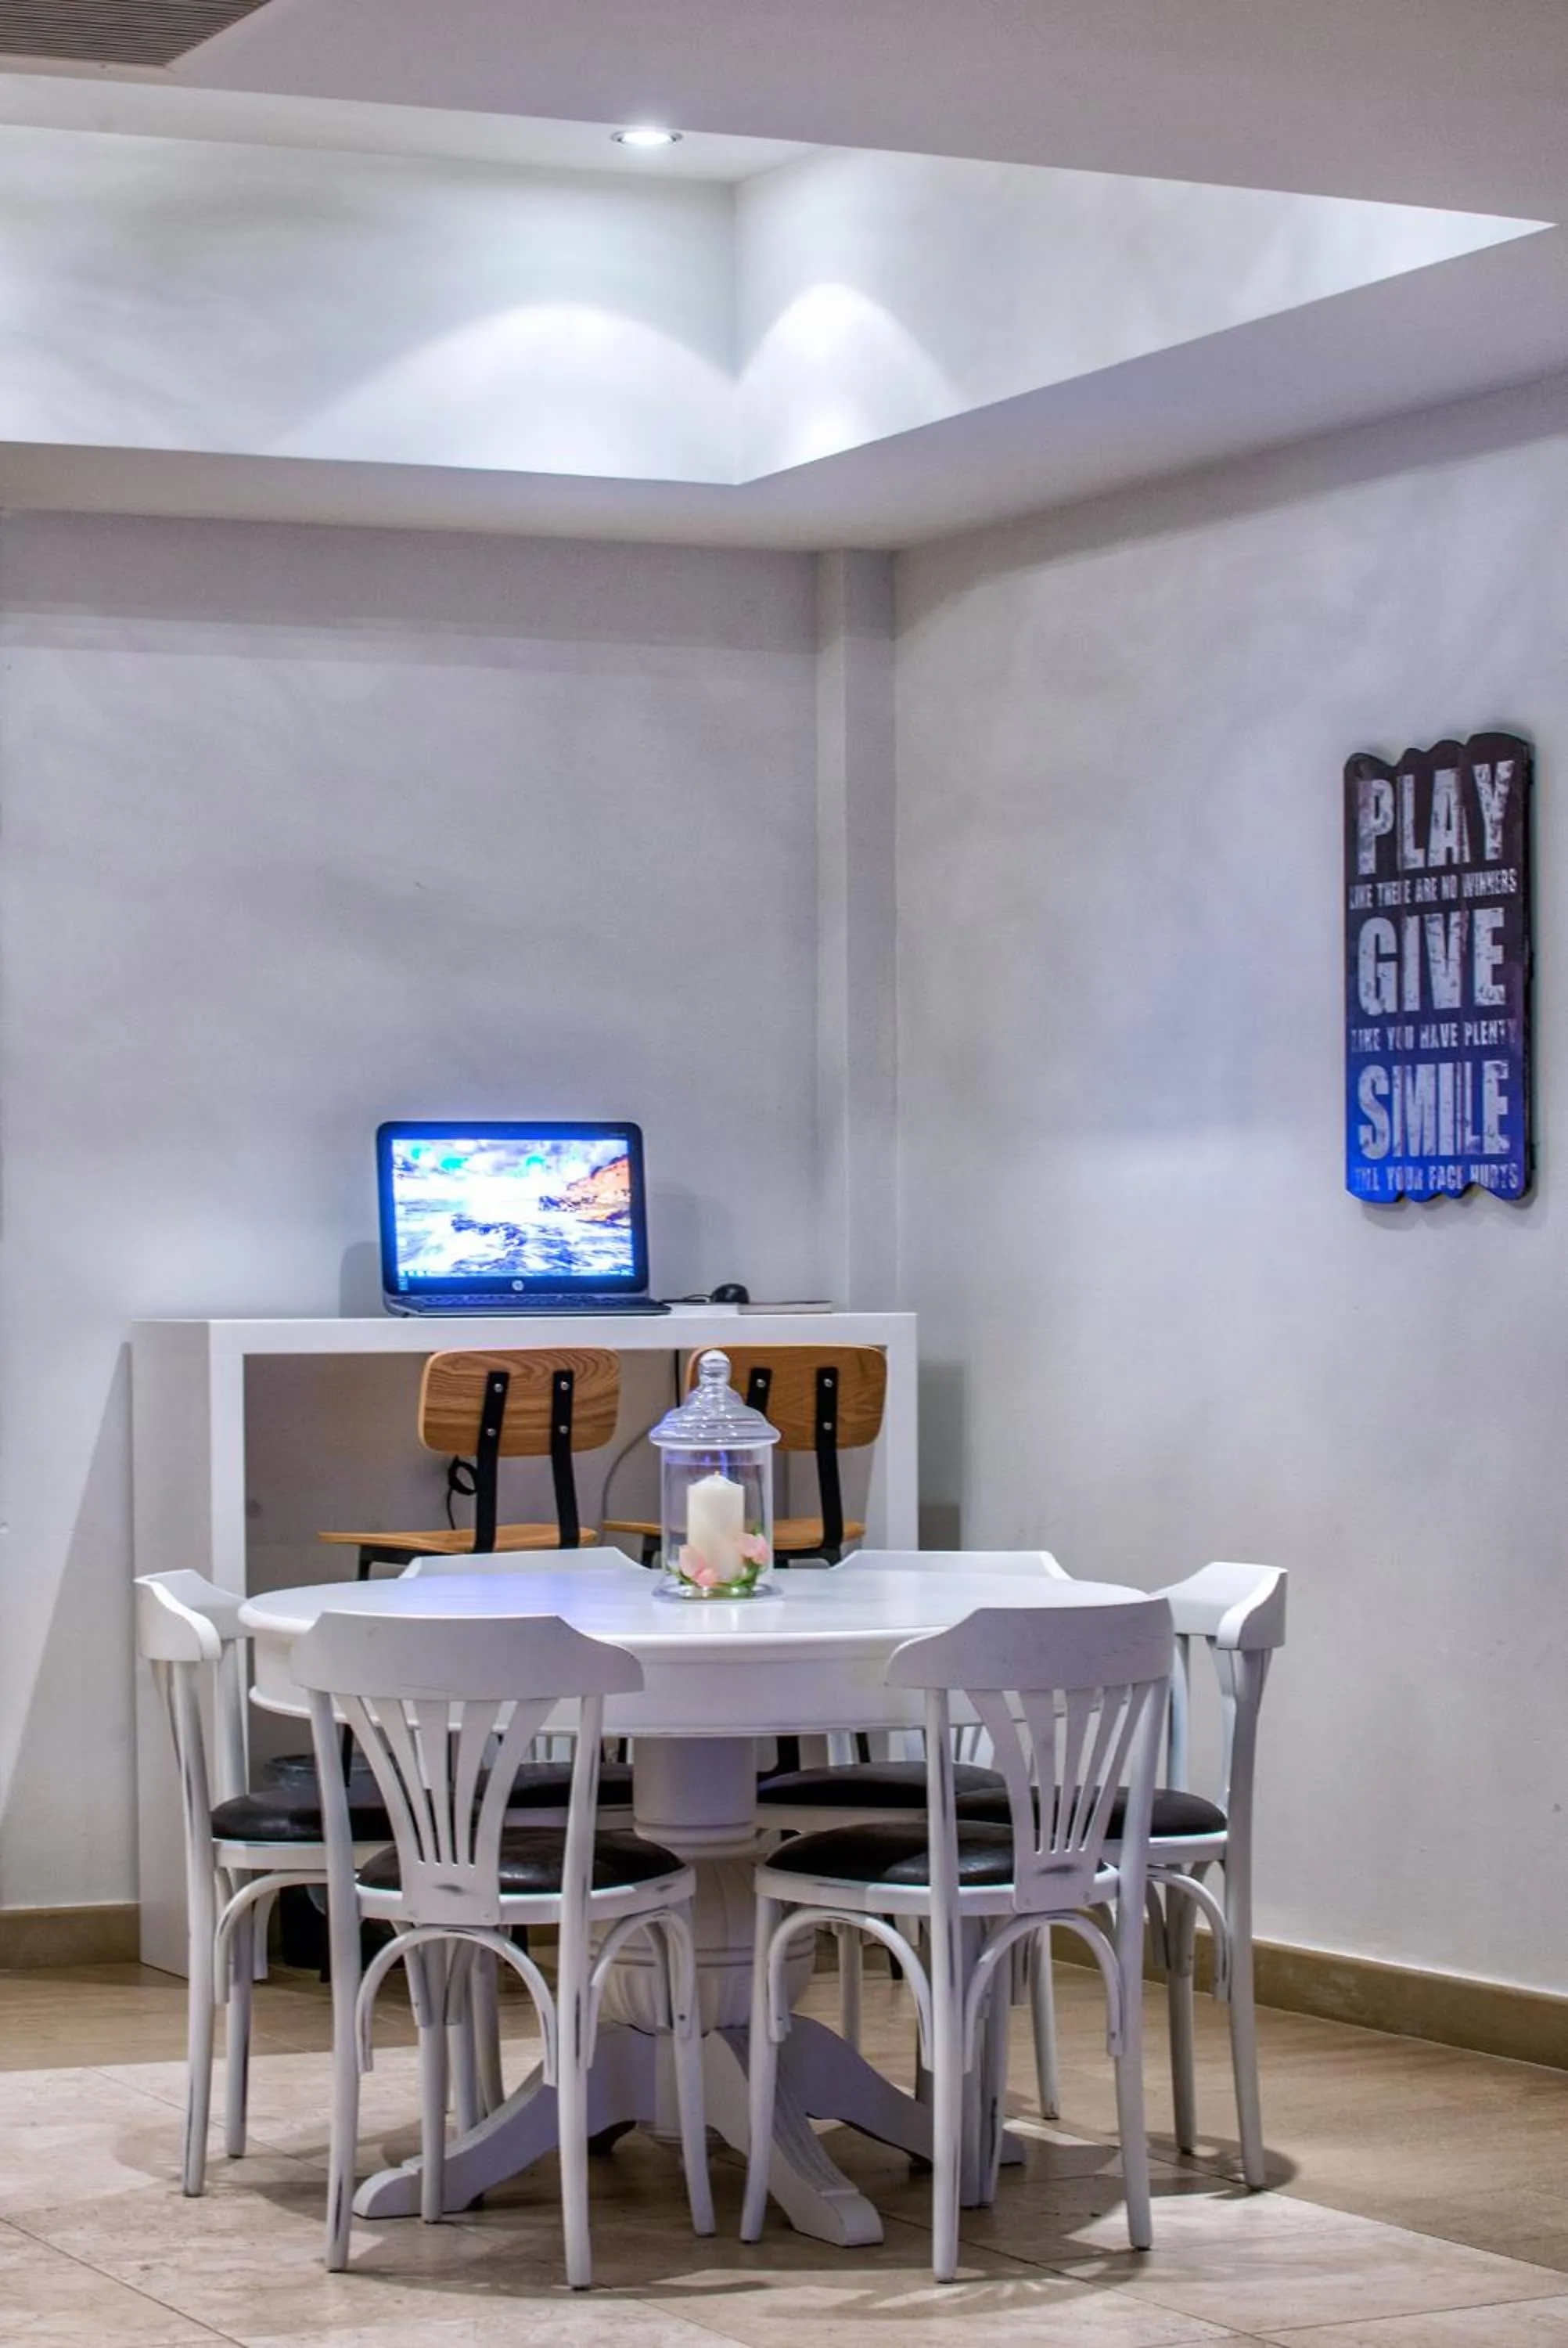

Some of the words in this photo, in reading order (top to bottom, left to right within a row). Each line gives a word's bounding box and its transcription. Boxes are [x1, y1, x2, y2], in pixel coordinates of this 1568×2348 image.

[1358, 760, 1515, 876] PLAY
[1415, 877, 1437, 902] ARE
[1441, 874, 1458, 900] NO
[1462, 868, 1517, 898] WINNERS
[1358, 907, 1505, 1016] GIVE
[1386, 1025, 1414, 1051] YOU
[1420, 1023, 1458, 1049] HAVE
[1358, 1060, 1511, 1160] SMILE
[1386, 1165, 1423, 1190] YOUR
[1429, 1164, 1462, 1190] FACE
[1469, 1163, 1518, 1189] HURTS
